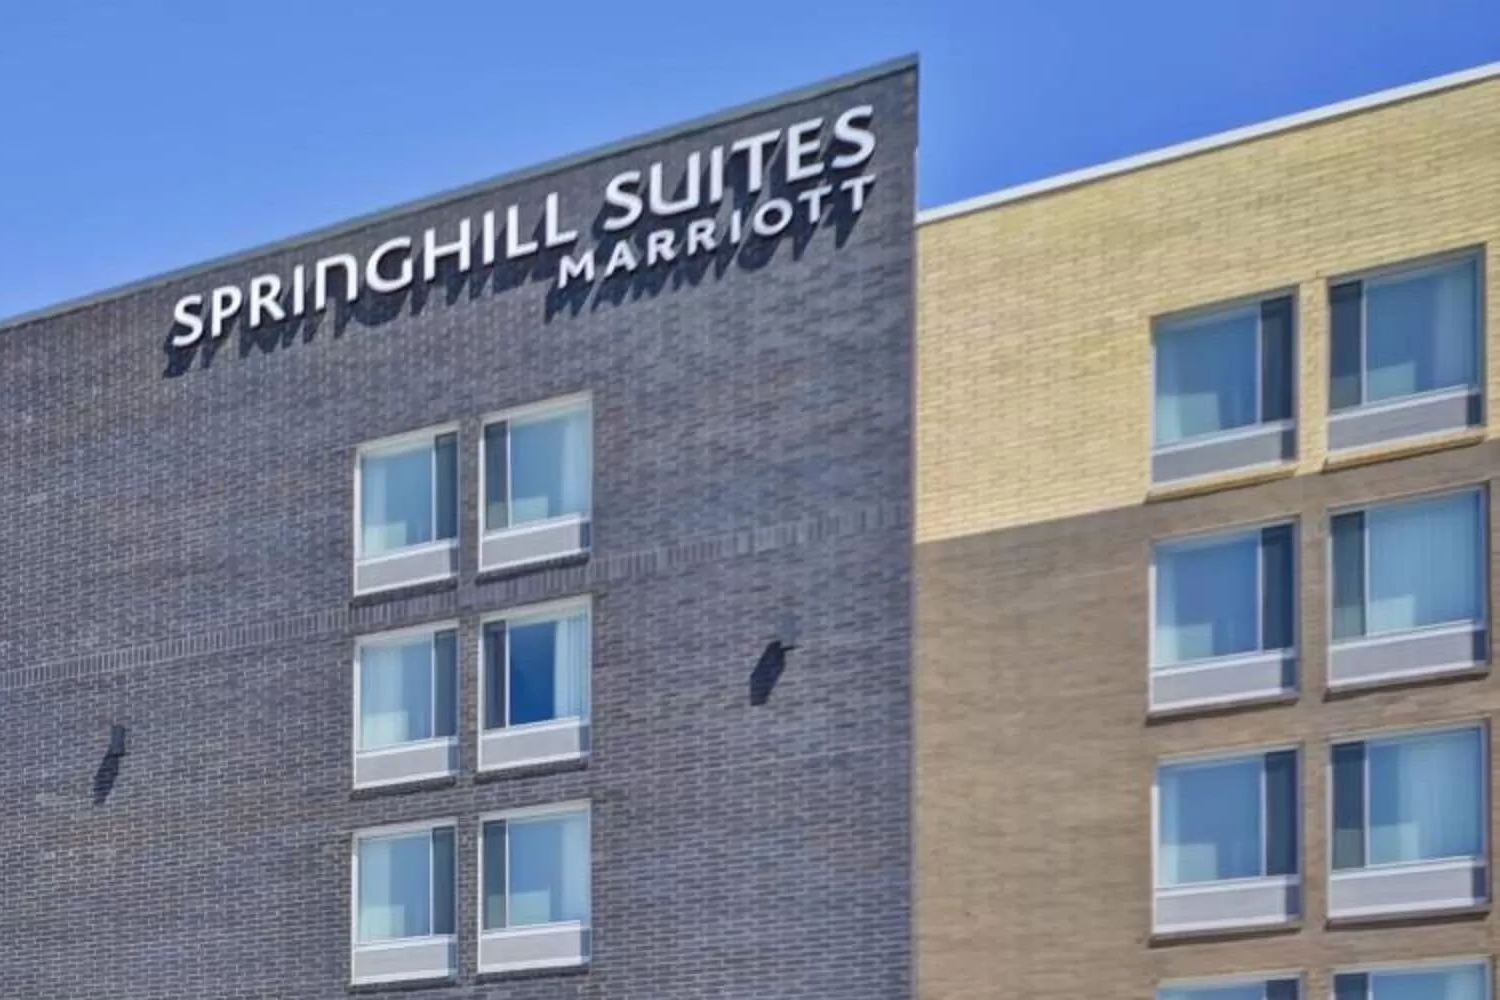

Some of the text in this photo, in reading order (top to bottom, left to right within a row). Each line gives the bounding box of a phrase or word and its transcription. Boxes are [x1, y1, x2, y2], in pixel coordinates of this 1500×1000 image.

[172, 105, 876, 346] SPRINGHILL SUITES
[556, 174, 875, 289] MARRIOTT
